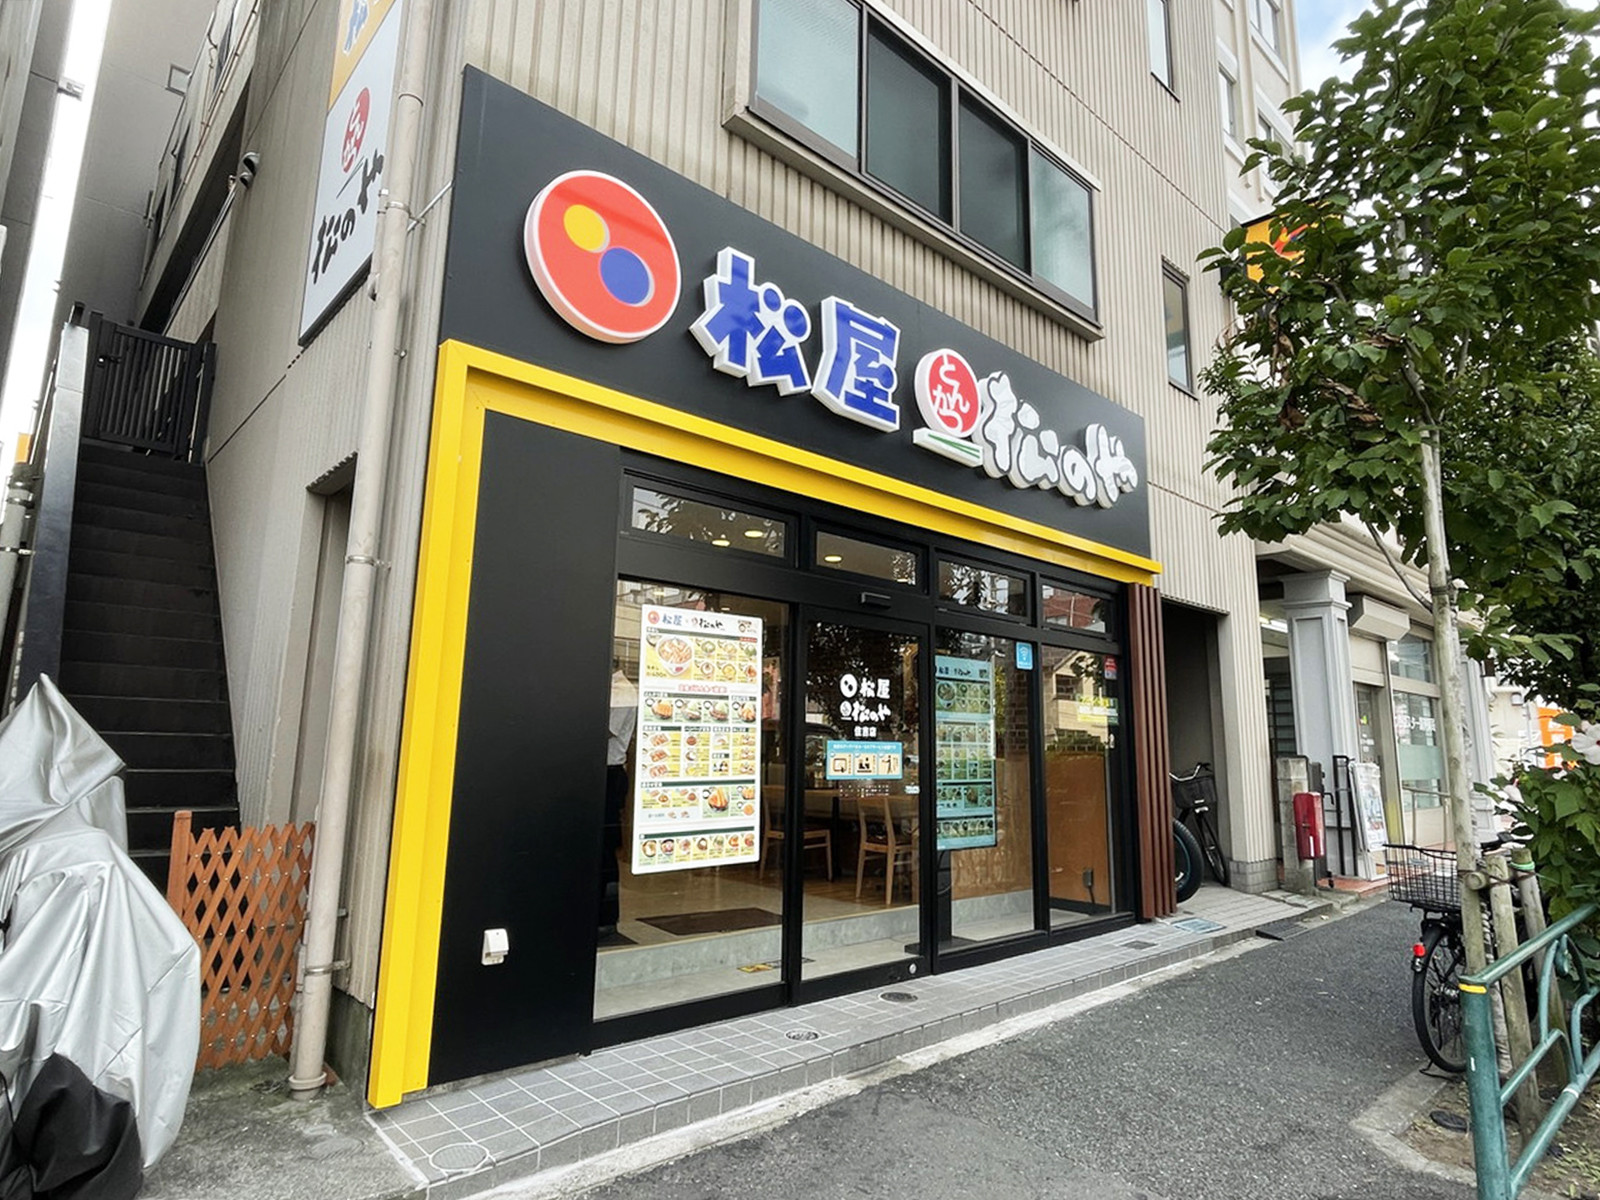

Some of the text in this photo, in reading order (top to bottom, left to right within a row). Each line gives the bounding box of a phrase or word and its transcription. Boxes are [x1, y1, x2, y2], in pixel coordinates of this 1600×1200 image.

[312, 148, 385, 286] 松のや
[692, 247, 902, 432] 松屋
[932, 353, 1138, 508] とんかつ 松のや
[851, 700, 892, 723] 松のや
[859, 677, 891, 700] 松屋
